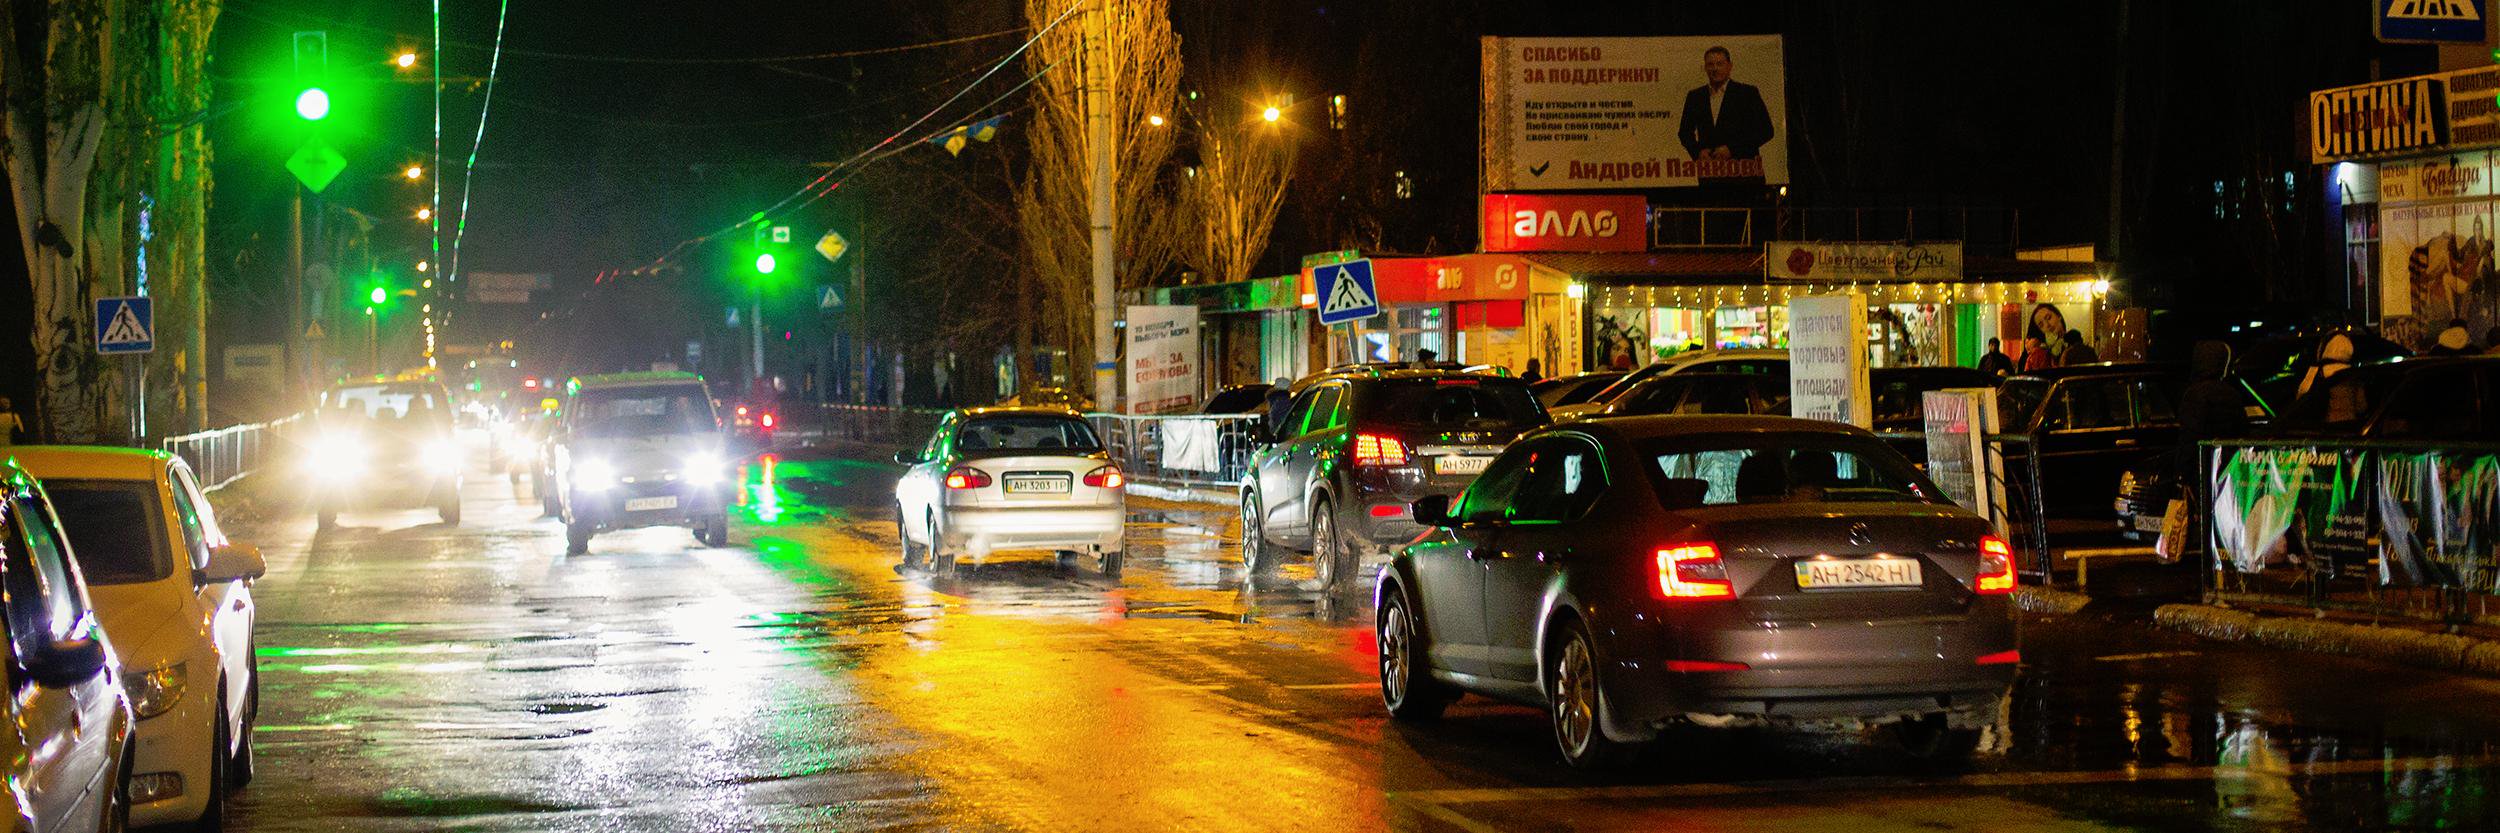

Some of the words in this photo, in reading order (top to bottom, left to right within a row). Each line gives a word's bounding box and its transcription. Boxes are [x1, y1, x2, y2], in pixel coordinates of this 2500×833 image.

[1523, 46, 1601, 62] СПАСИБО
[1523, 68, 1545, 83] ЗА
[1549, 67, 1659, 85] ПОДДЕРЖКУ!
[2313, 79, 2436, 156] ОПТИКА
[1568, 157, 1660, 182] Андрей
[2383, 184, 2405, 198] МЕХА
[1795, 314, 1843, 338] сдаются
[1169, 352, 1184, 364] ЗА
[1793, 346, 1846, 370] торговые
[1796, 378, 1846, 400] площади
[1442, 460, 1458, 472] AH
[1460, 459, 1482, 471] 5977
[1014, 481, 1027, 491] AH
[1030, 481, 1051, 491] 3203
[1812, 567, 1840, 586] AH
[1844, 566, 1884, 584] 2542
[1891, 564, 1915, 582] HI
